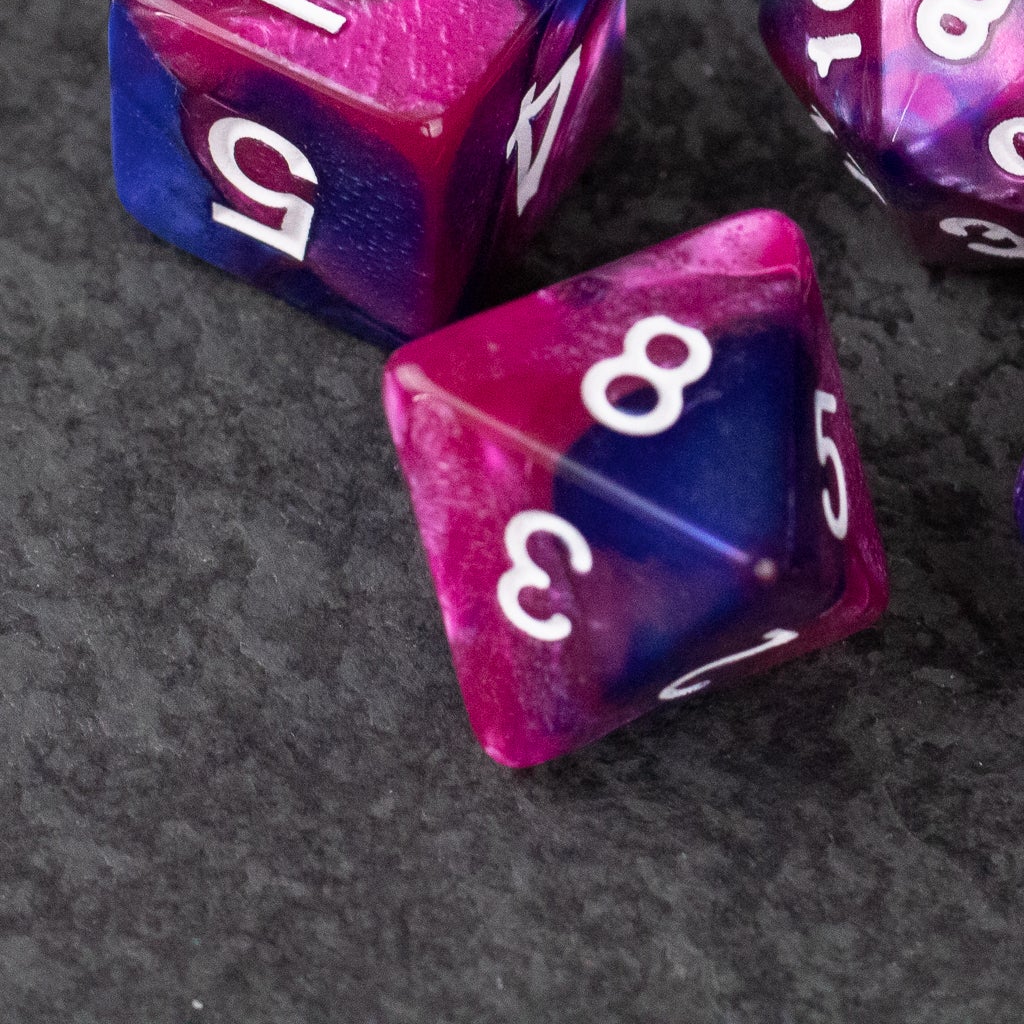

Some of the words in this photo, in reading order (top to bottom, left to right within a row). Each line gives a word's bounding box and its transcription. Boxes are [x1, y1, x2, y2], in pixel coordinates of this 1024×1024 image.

[207, 116, 319, 262] 5
[505, 43, 584, 218] 4
[581, 314, 713, 437] 8
[813, 389, 849, 540] 5
[496, 509, 594, 643] 3
